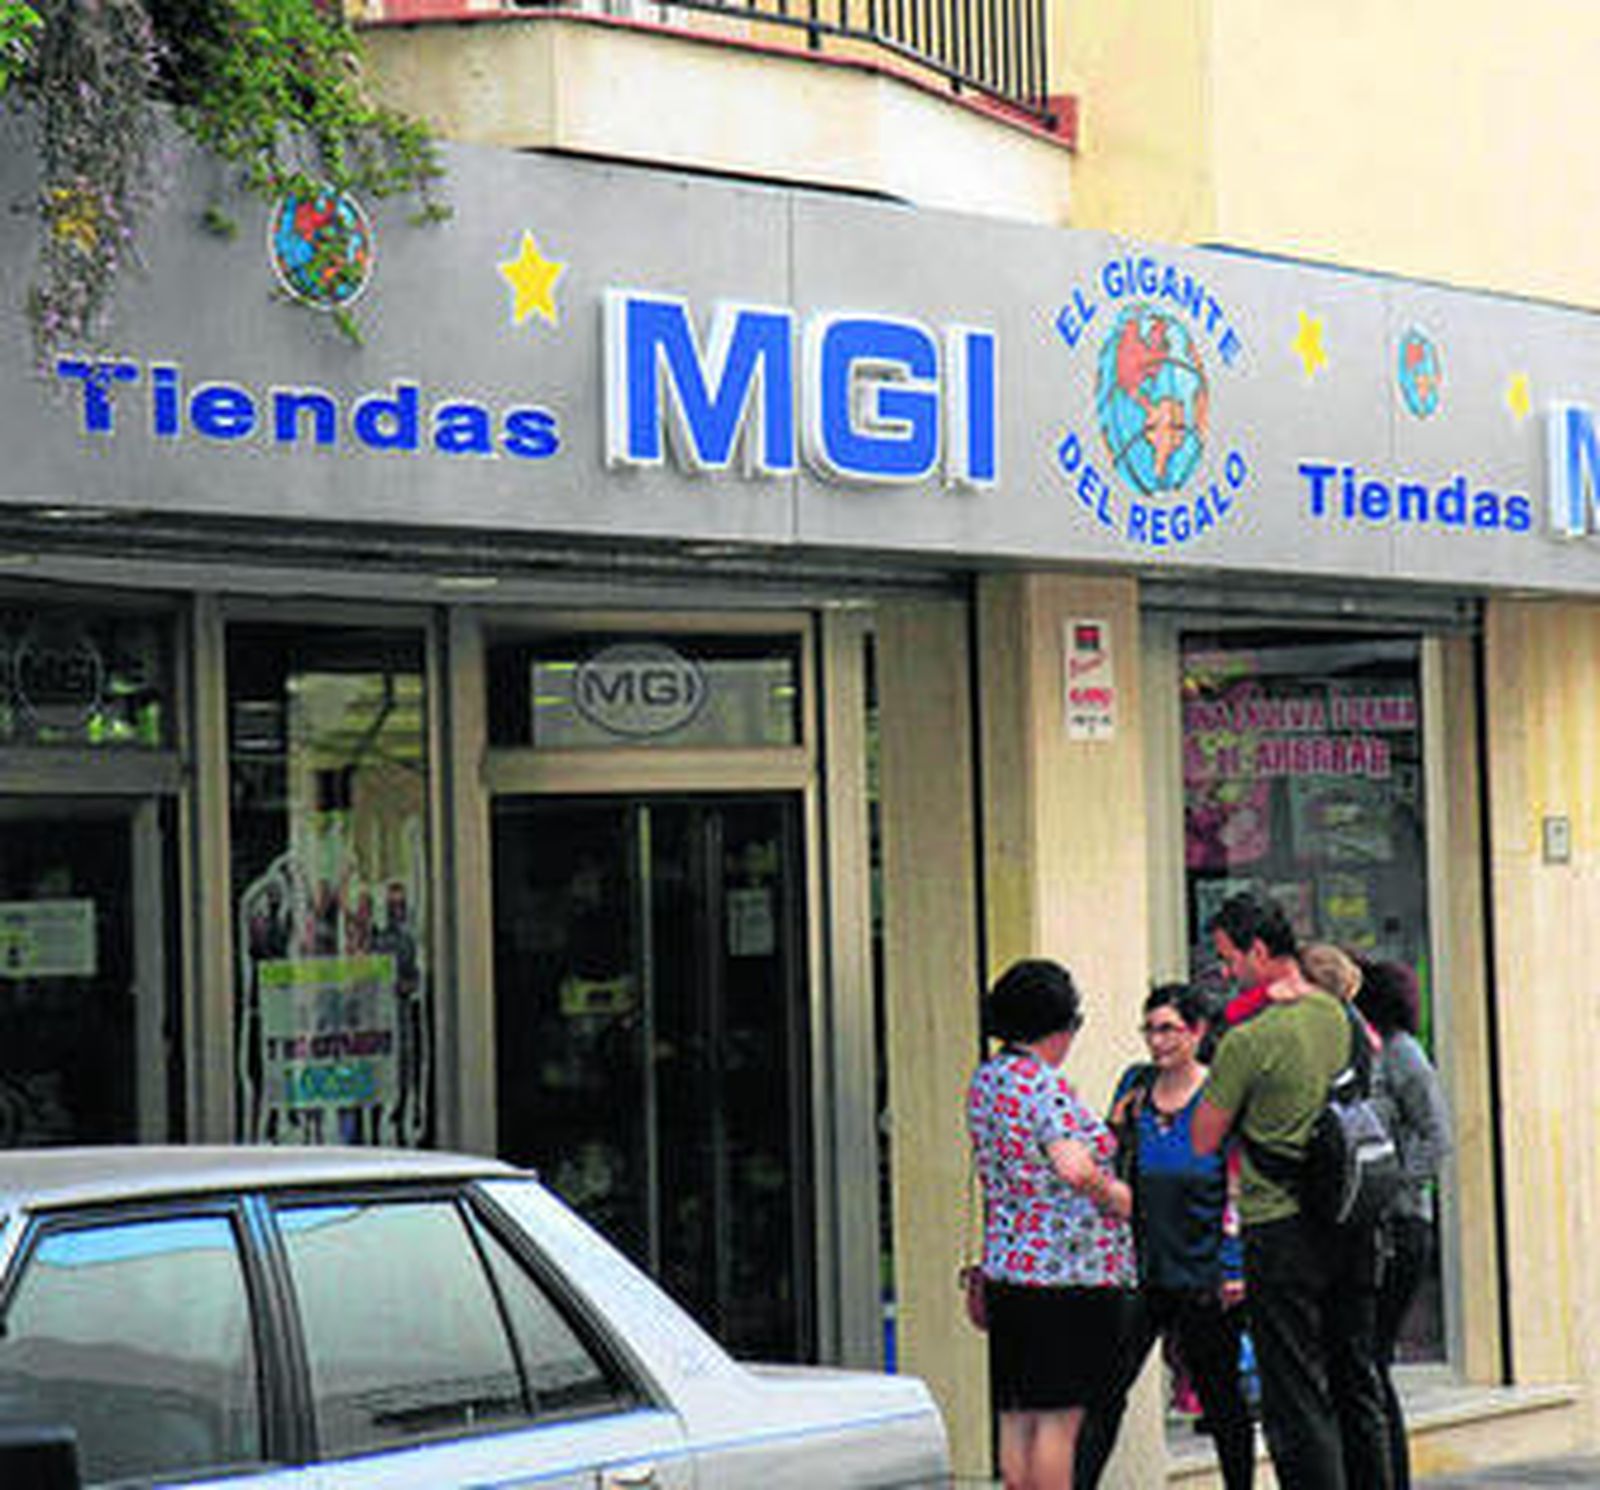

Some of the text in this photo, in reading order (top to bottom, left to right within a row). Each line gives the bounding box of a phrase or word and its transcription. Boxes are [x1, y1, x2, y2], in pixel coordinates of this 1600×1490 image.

[1056, 257, 1241, 367] EL GIGANTE
[56, 290, 997, 486] Tiendas MGI
[1058, 432, 1247, 545] DEL REGALO
[1297, 463, 1532, 532] Tiendas
[584, 669, 694, 706] MGI
